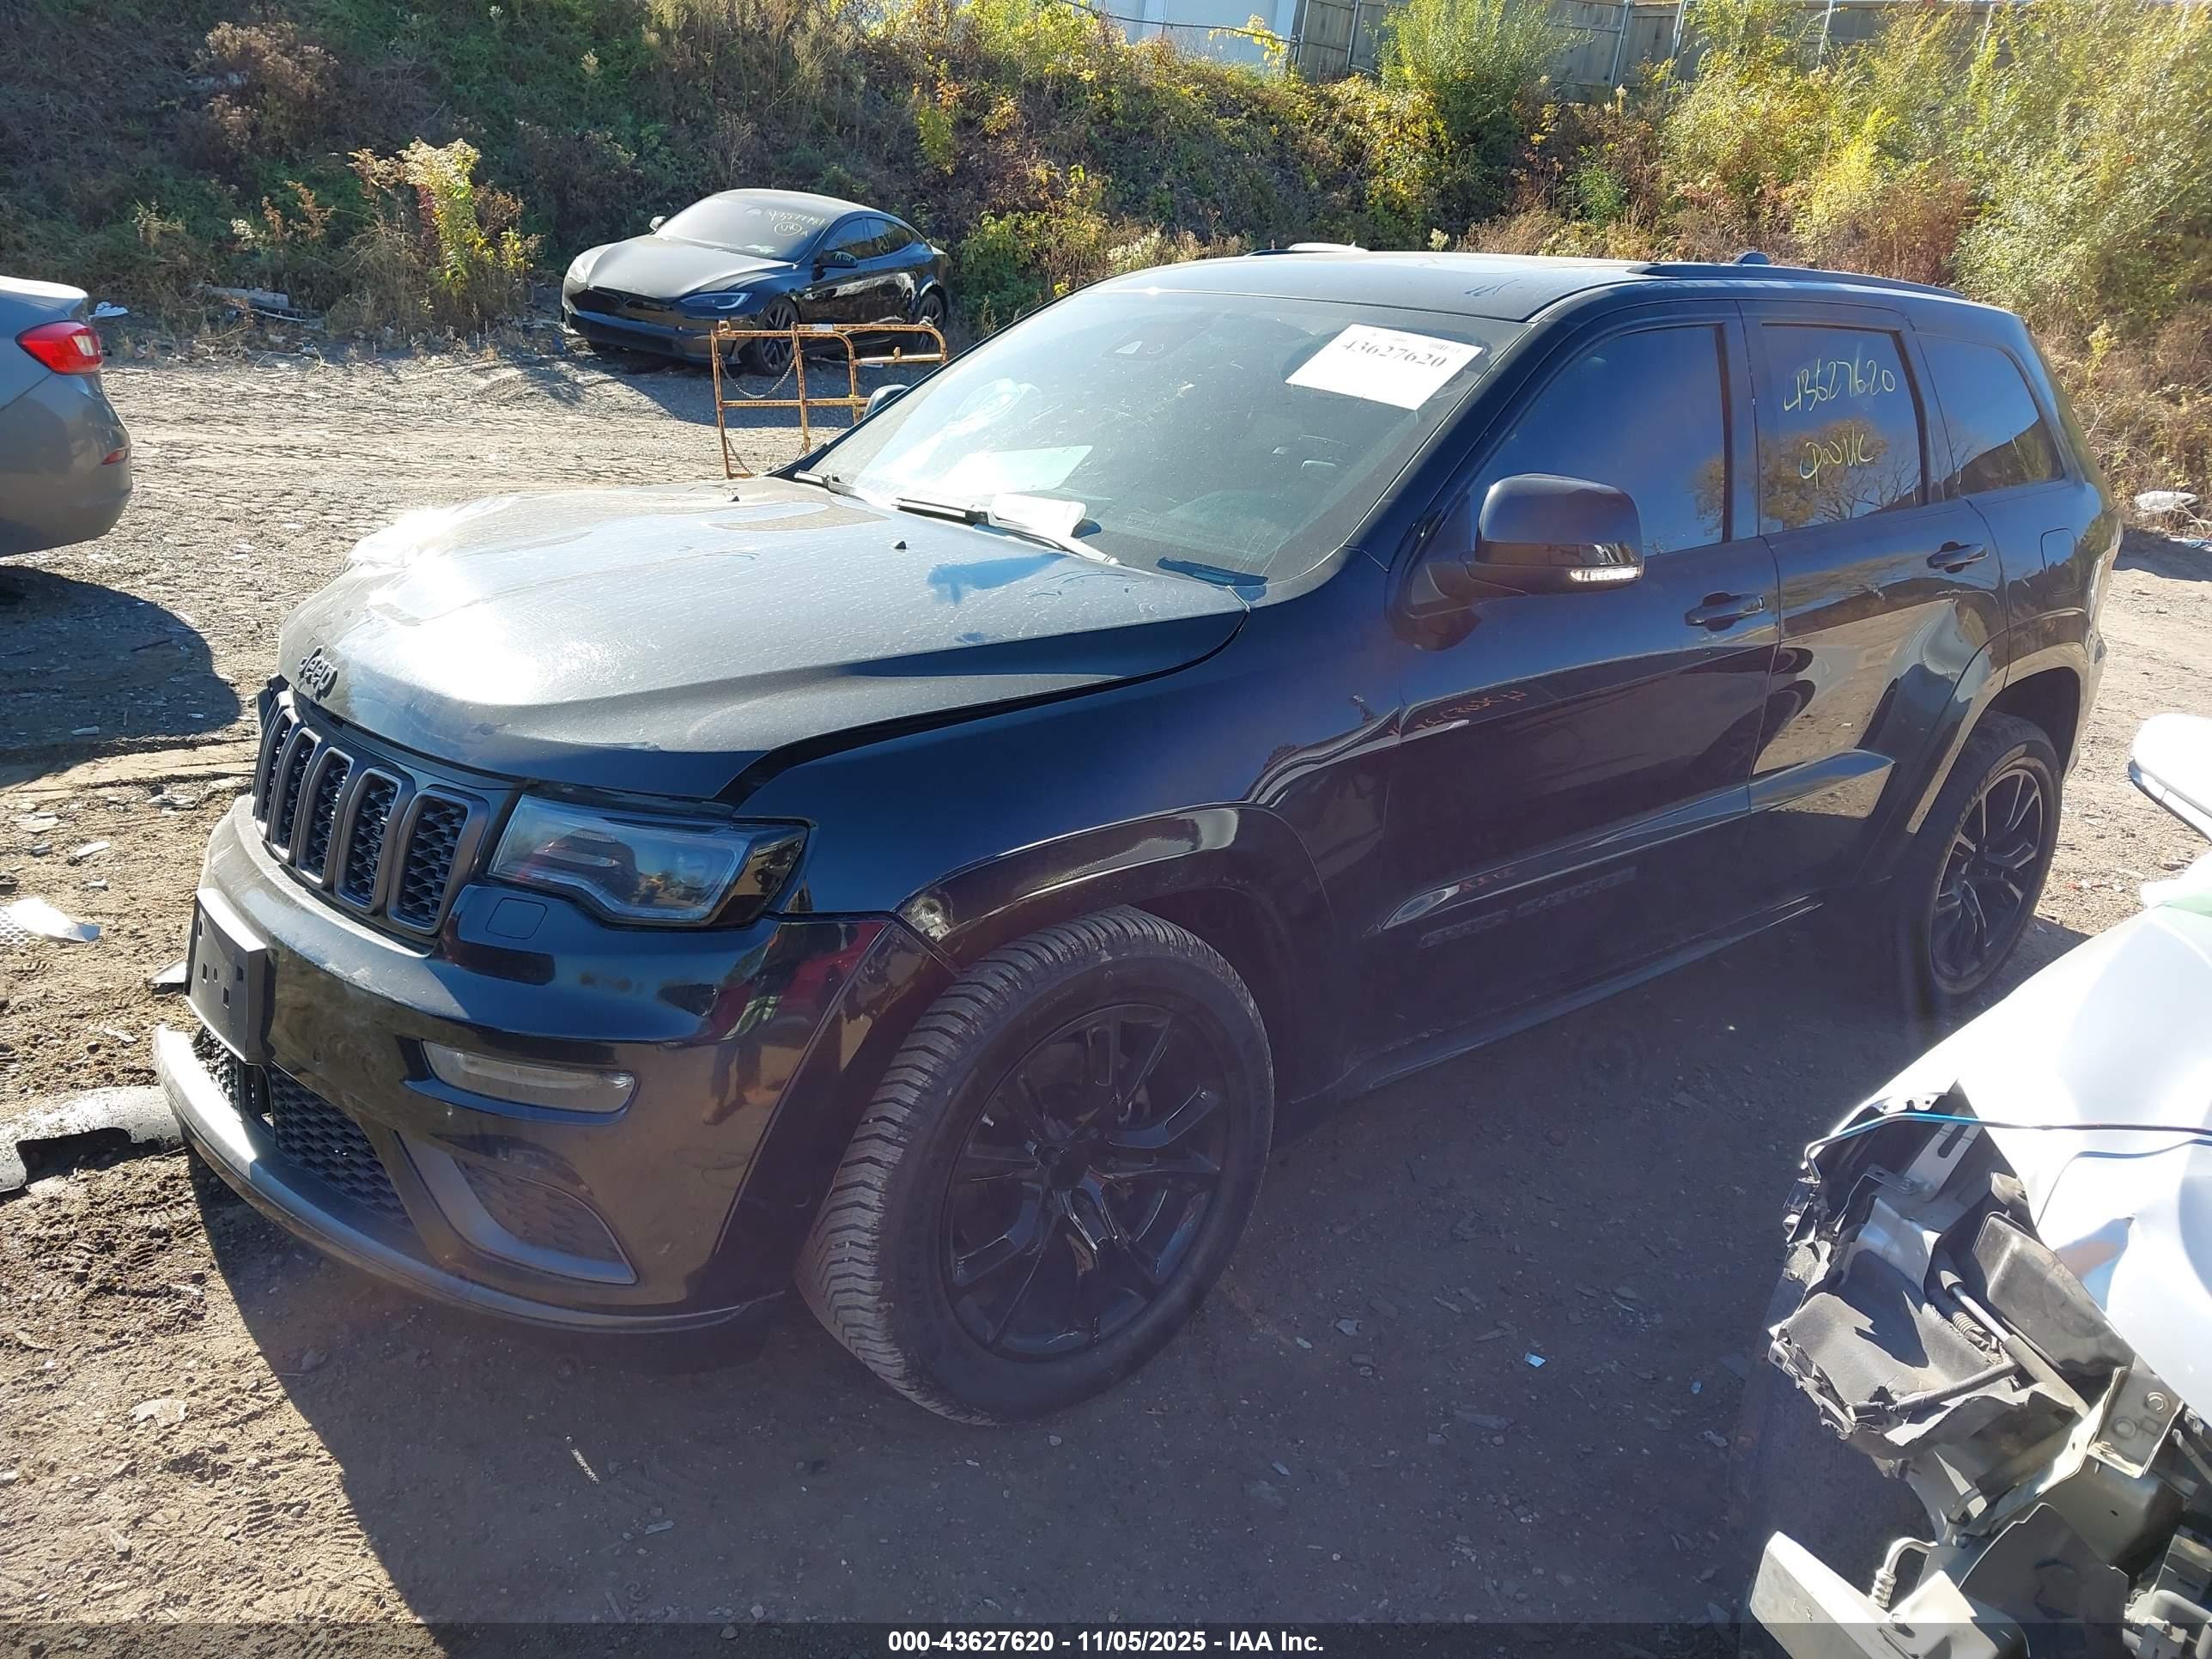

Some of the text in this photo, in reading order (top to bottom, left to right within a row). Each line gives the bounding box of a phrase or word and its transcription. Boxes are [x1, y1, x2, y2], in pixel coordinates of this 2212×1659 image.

[1342, 340, 1447, 368] 43627620
[1784, 357, 1896, 412] 43627620
[297, 645, 338, 702] Jeep
